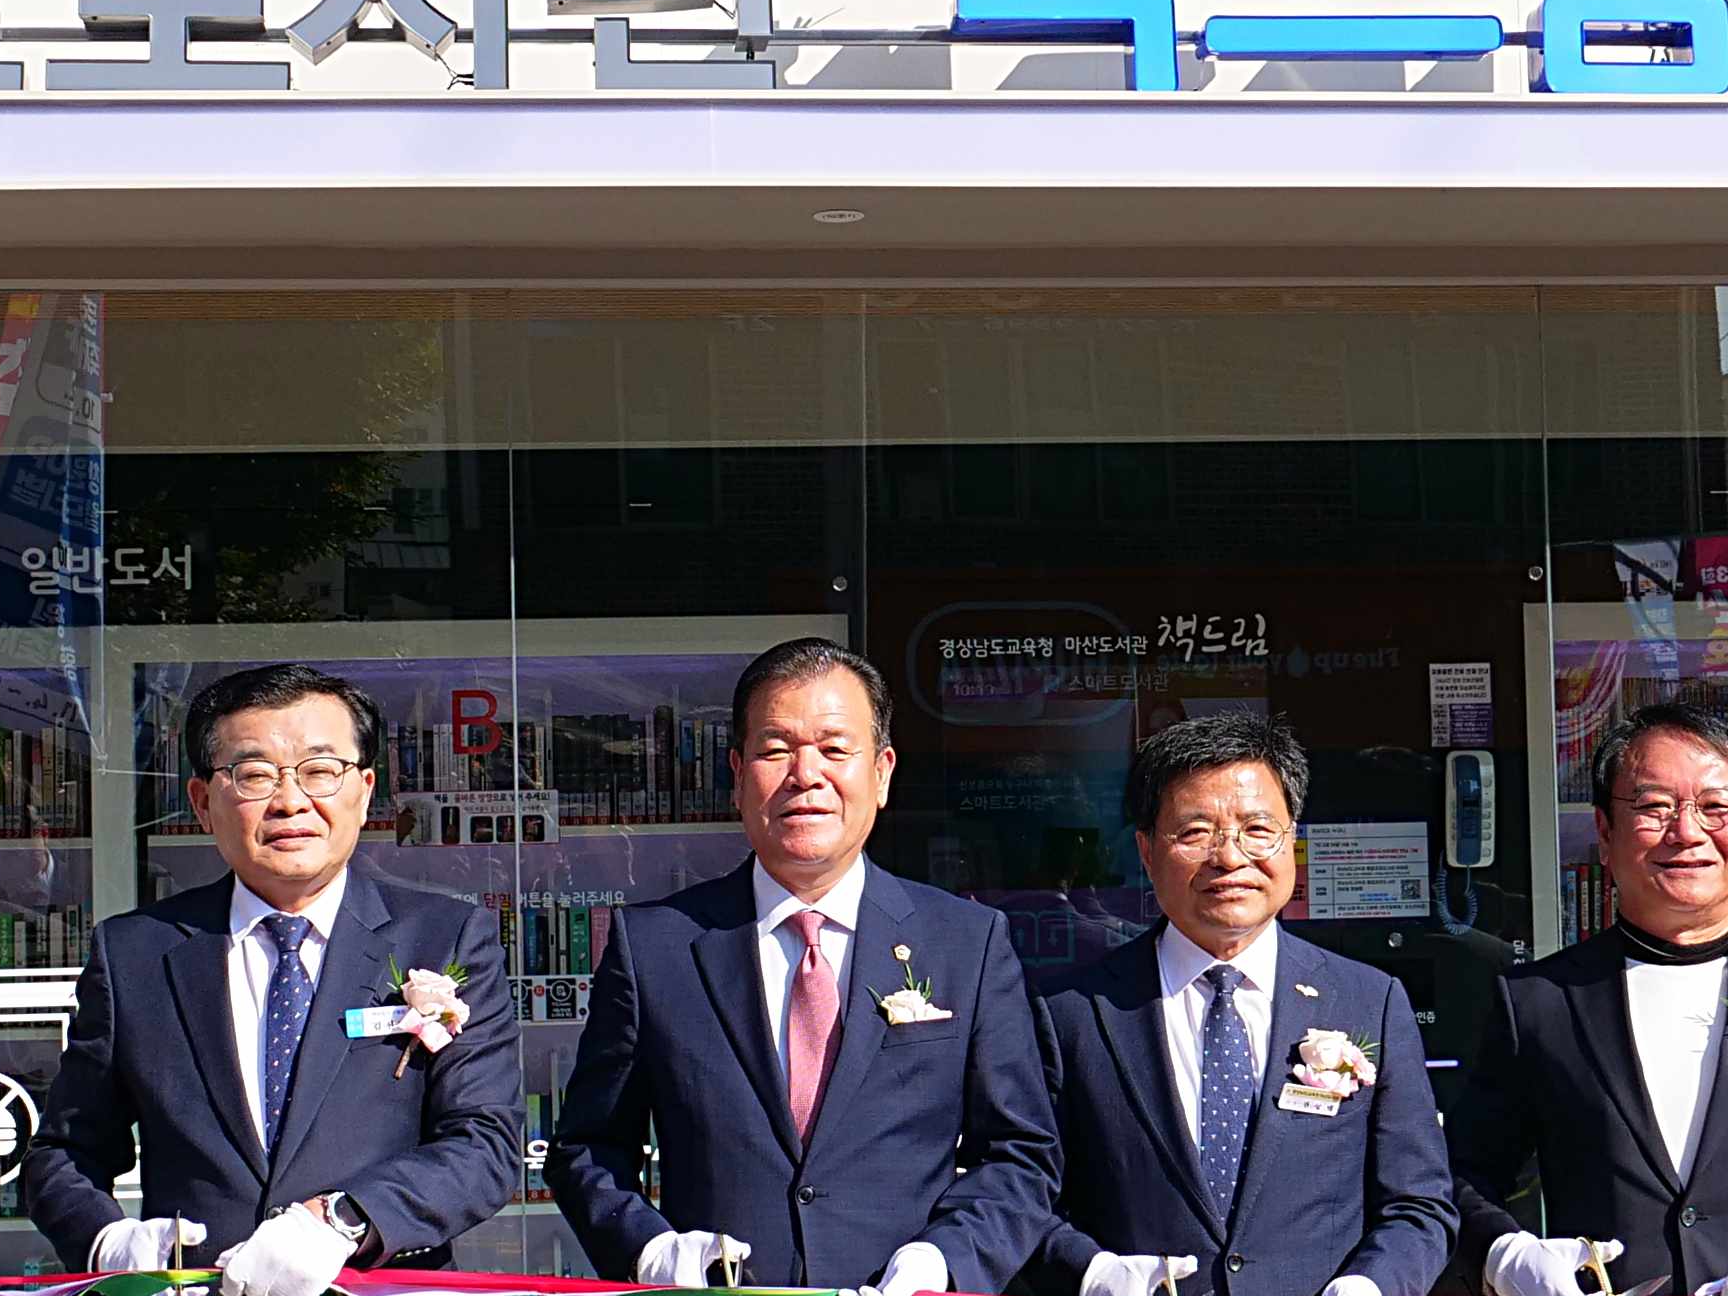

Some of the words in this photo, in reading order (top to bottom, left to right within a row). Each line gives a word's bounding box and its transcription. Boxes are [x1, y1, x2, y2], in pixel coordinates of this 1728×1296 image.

[21, 544, 192, 595] 일반도서
[939, 637, 1054, 658] 경상남도교육청
[1065, 635, 1149, 656] 마산도서관
[1157, 613, 1270, 662] 책드림
[451, 689, 503, 754] B
[558, 890, 626, 909] 눌러주세요
